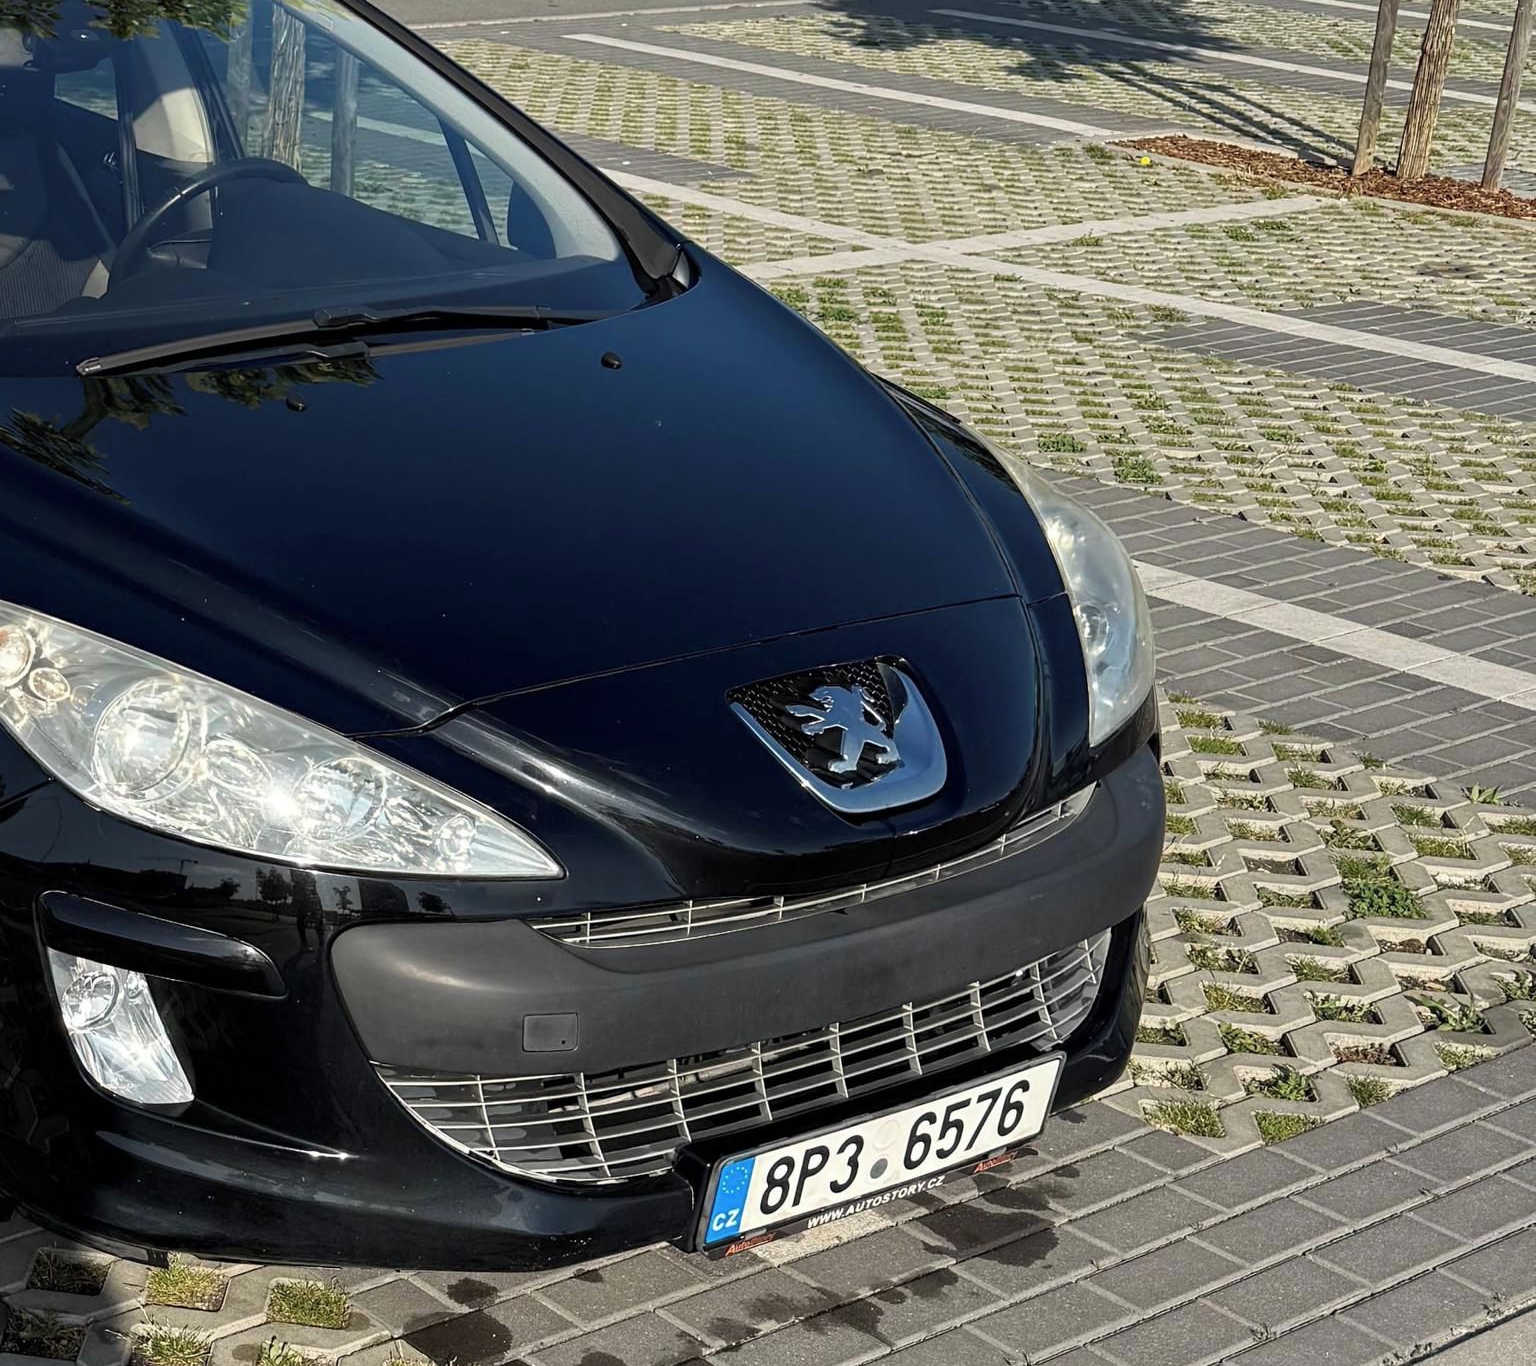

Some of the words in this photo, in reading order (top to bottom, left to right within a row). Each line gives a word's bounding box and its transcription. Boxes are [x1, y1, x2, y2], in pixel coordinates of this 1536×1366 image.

[759, 1135, 865, 1216] 8P3
[903, 1079, 1030, 1170] 6576
[711, 1207, 740, 1233] CZ
[807, 1174, 946, 1230] WWW.AUTOSTORY.CZ
